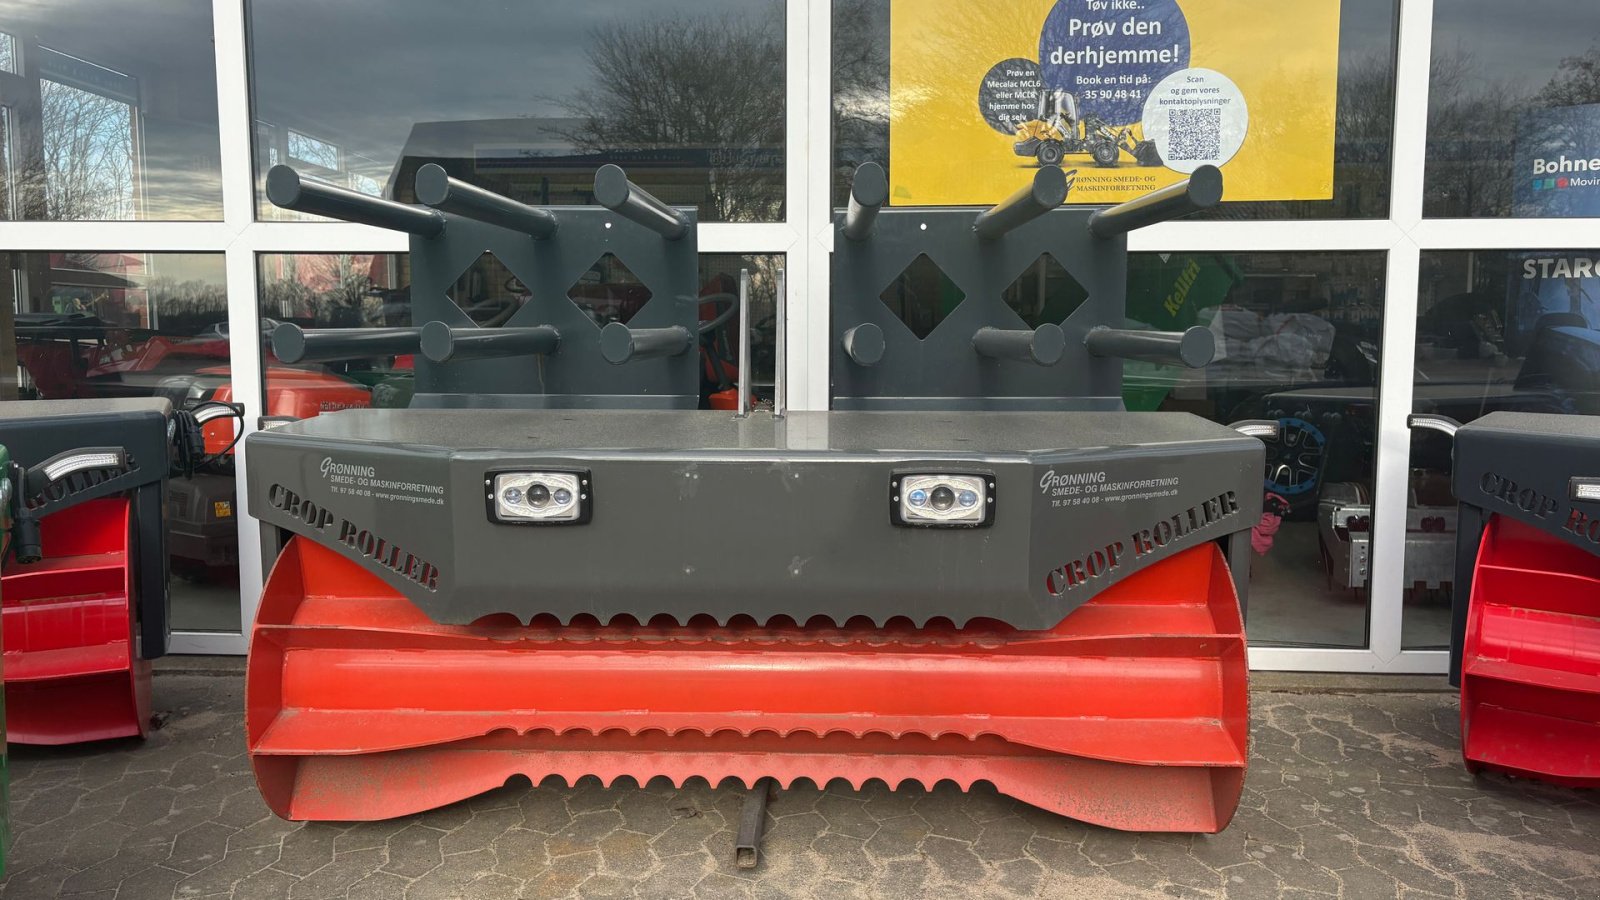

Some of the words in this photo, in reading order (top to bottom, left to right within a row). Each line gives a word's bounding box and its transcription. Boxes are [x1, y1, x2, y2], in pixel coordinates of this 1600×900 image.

[1069, 18, 1116, 38] Prøv
[1122, 16, 1161, 36] den
[1050, 44, 1179, 68] derhjemme!
[1006, 69, 1025, 77] Prøv
[1076, 74, 1102, 85] Book
[1104, 76, 1117, 85] en
[1119, 74, 1133, 84] tid
[1135, 74, 1152, 87] på:
[987, 80, 1018, 88] Mecalac
[1020, 79, 1041, 88] MCL6
[996, 91, 1012, 99] eller
[1084, 90, 1097, 99] 35
[1099, 89, 1112, 99] 90
[1114, 89, 1128, 99] 48
[1129, 89, 1142, 99] 41
[1159, 98, 1232, 106] kontaktoplysninger
[989, 102, 1020, 111] hjemme
[1021, 102, 1035, 110] hos
[998, 113, 1010, 122] dig
[1011, 113, 1027, 121] selv
[1533, 155, 1600, 175] Bohne
[1076, 184, 1156, 192] MASKINFORRETNING
[319, 456, 375, 478] GRØNNING
[330, 474, 356, 485] SMEDE-
[357, 477, 369, 487] OG
[370, 479, 444, 495] MASKINFORRETNING
[1040, 470, 1106, 494] GRØNNING
[1051, 485, 1083, 497] SMEDE-
[1085, 484, 1098, 494] OG
[1099, 477, 1179, 493] MASKINFORRETNING
[1062, 498, 1072, 506] 97
[1082, 497, 1091, 505] 40
[1480, 472, 1559, 520] CROP
[269, 483, 334, 533] CROP
[338, 518, 439, 592] ROLLER
[1046, 541, 1124, 597] CROP
[1131, 490, 1240, 559] ROLLER
